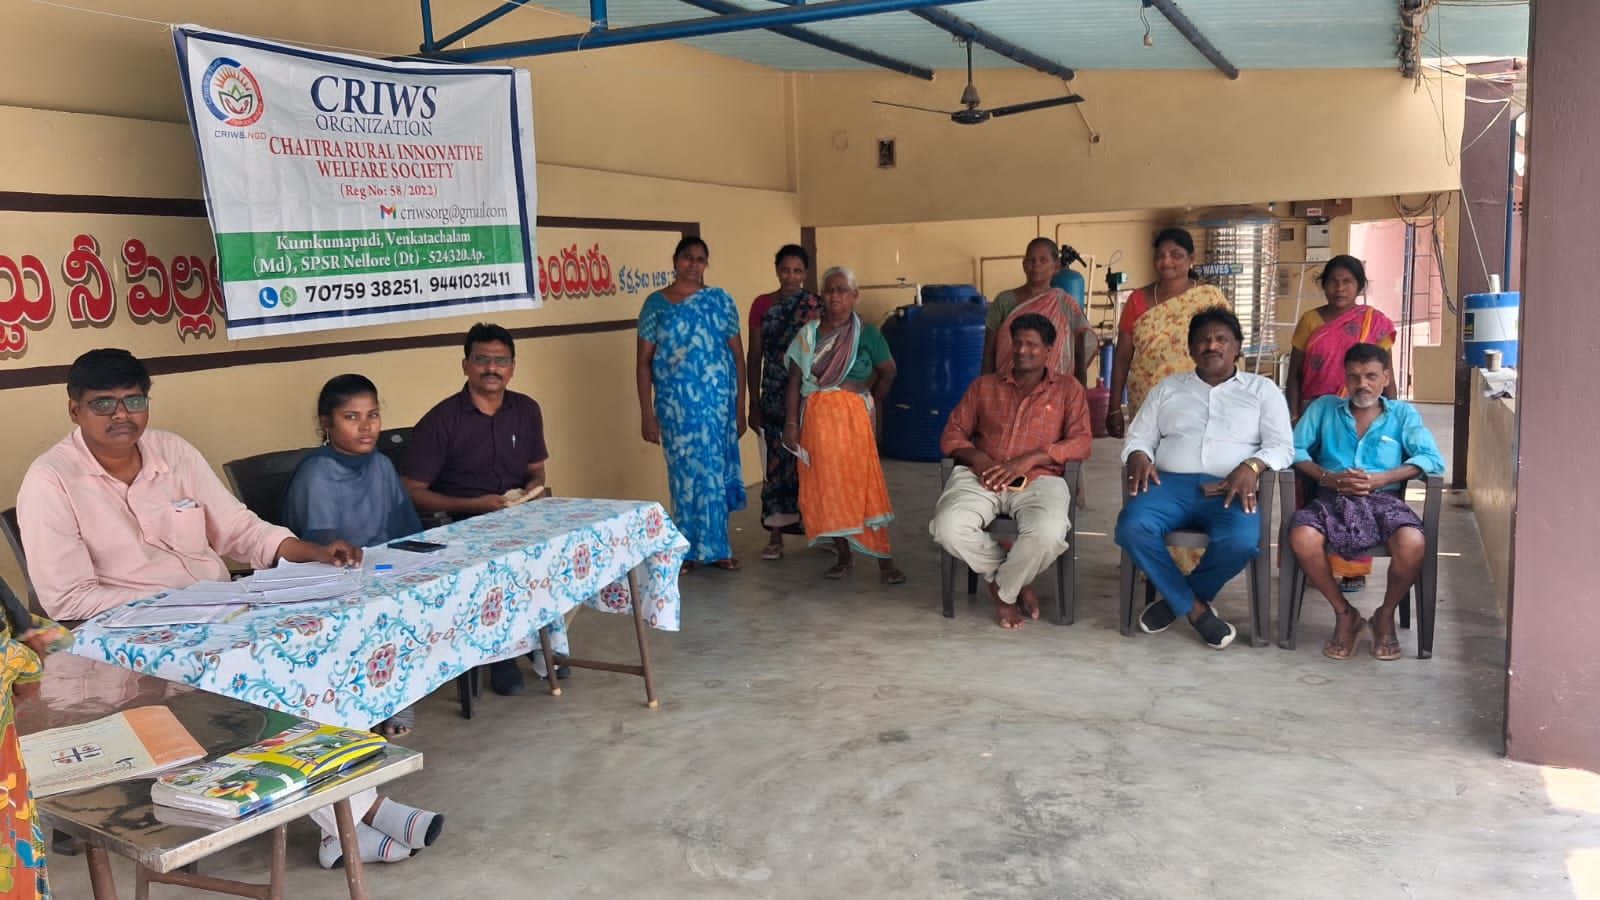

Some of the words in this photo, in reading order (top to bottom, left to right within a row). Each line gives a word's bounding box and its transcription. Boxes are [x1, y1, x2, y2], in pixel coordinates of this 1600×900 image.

[310, 75, 437, 119] CRIWS
[315, 114, 433, 136] ORGNIZATION
[269, 136, 343, 158] CHAITRA
[345, 141, 395, 160] RURAL
[399, 143, 484, 161] INNOVATIVE
[316, 159, 388, 178] WELFARE
[391, 162, 455, 179] SOCIETY
[340, 183, 366, 200] (Reg
[368, 184, 387, 197] No:
[276, 231, 384, 252] Kumkumapudi,
[386, 229, 471, 246] Venkatachalam
[253, 255, 298, 277] (Md),
[301, 254, 342, 272] SPSR
[343, 252, 391, 269] Nellore
[394, 249, 420, 267] (Dt)
[1203, 263, 1230, 275] WAVES
[63, 233, 115, 323] నీ
[305, 282, 366, 303] 70759
[371, 278, 423, 298] 38251,
[430, 271, 511, 293] 9441032411
